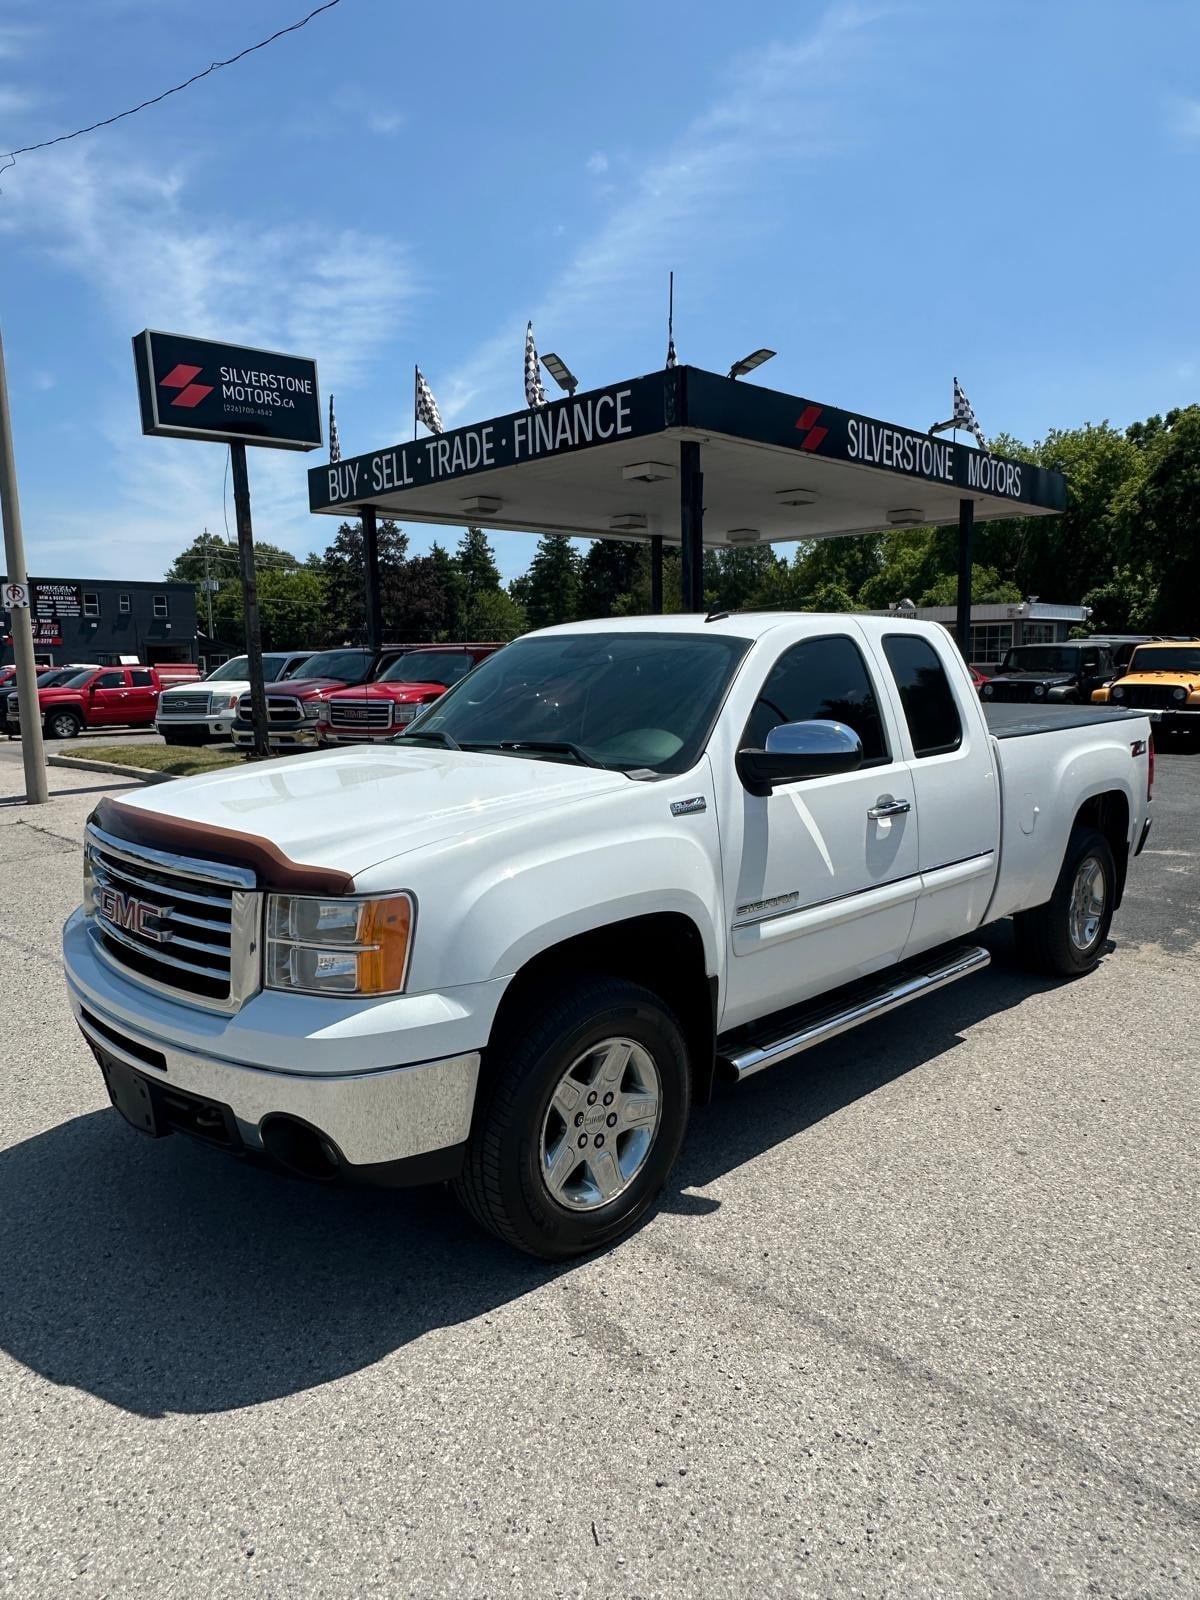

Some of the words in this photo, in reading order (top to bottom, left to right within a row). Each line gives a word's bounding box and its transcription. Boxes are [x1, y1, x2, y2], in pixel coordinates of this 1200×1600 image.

[220, 366, 312, 394] SILVERSTONE
[222, 384, 295, 408] MOTORS.CA
[328, 463, 359, 501] BUY
[372, 450, 413, 491] SELL
[425, 427, 495, 478] TRADE
[514, 389, 632, 458] FINANCE
[847, 419, 954, 481] SILVERSTONE
[968, 453, 1021, 497] MOTORS
[100, 885, 167, 942] GMC
